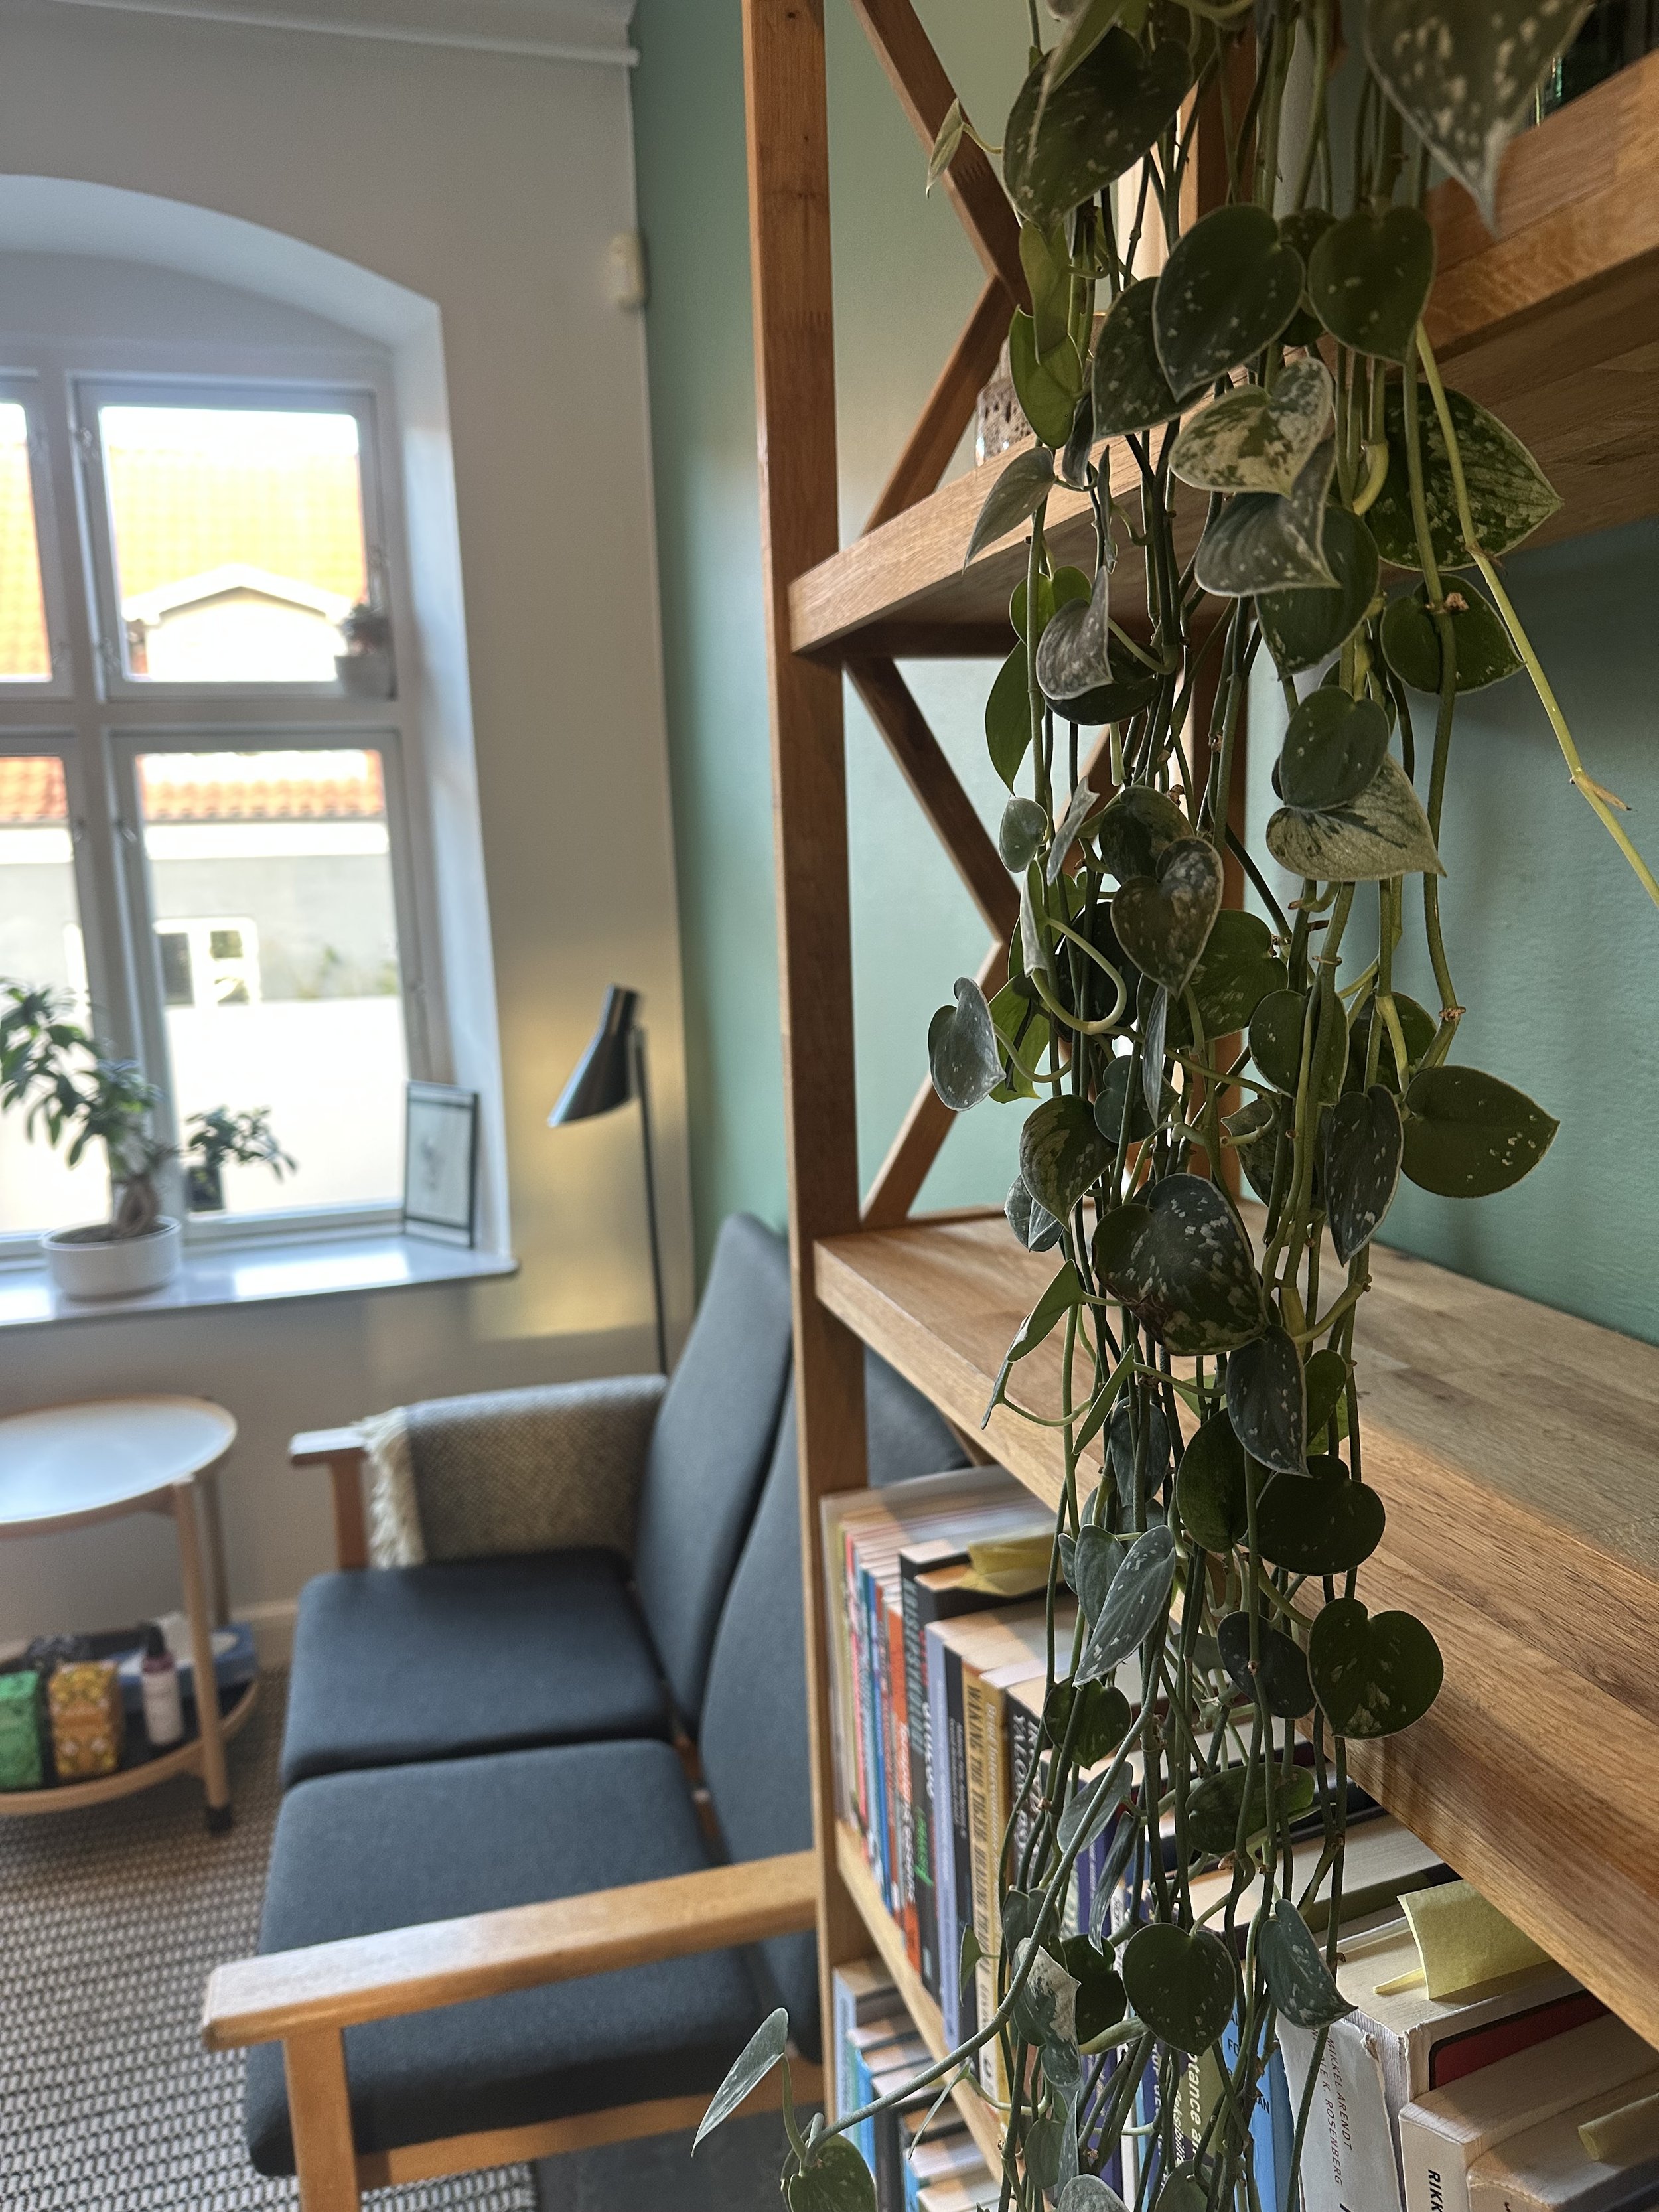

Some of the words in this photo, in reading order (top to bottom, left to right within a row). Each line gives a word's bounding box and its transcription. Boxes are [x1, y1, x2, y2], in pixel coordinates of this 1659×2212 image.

[1325, 2098, 1342, 2186] ROSENBERG
[1327, 2037, 1343, 2088] MIKKEL
[1336, 2091, 1352, 2151] ARENDT
